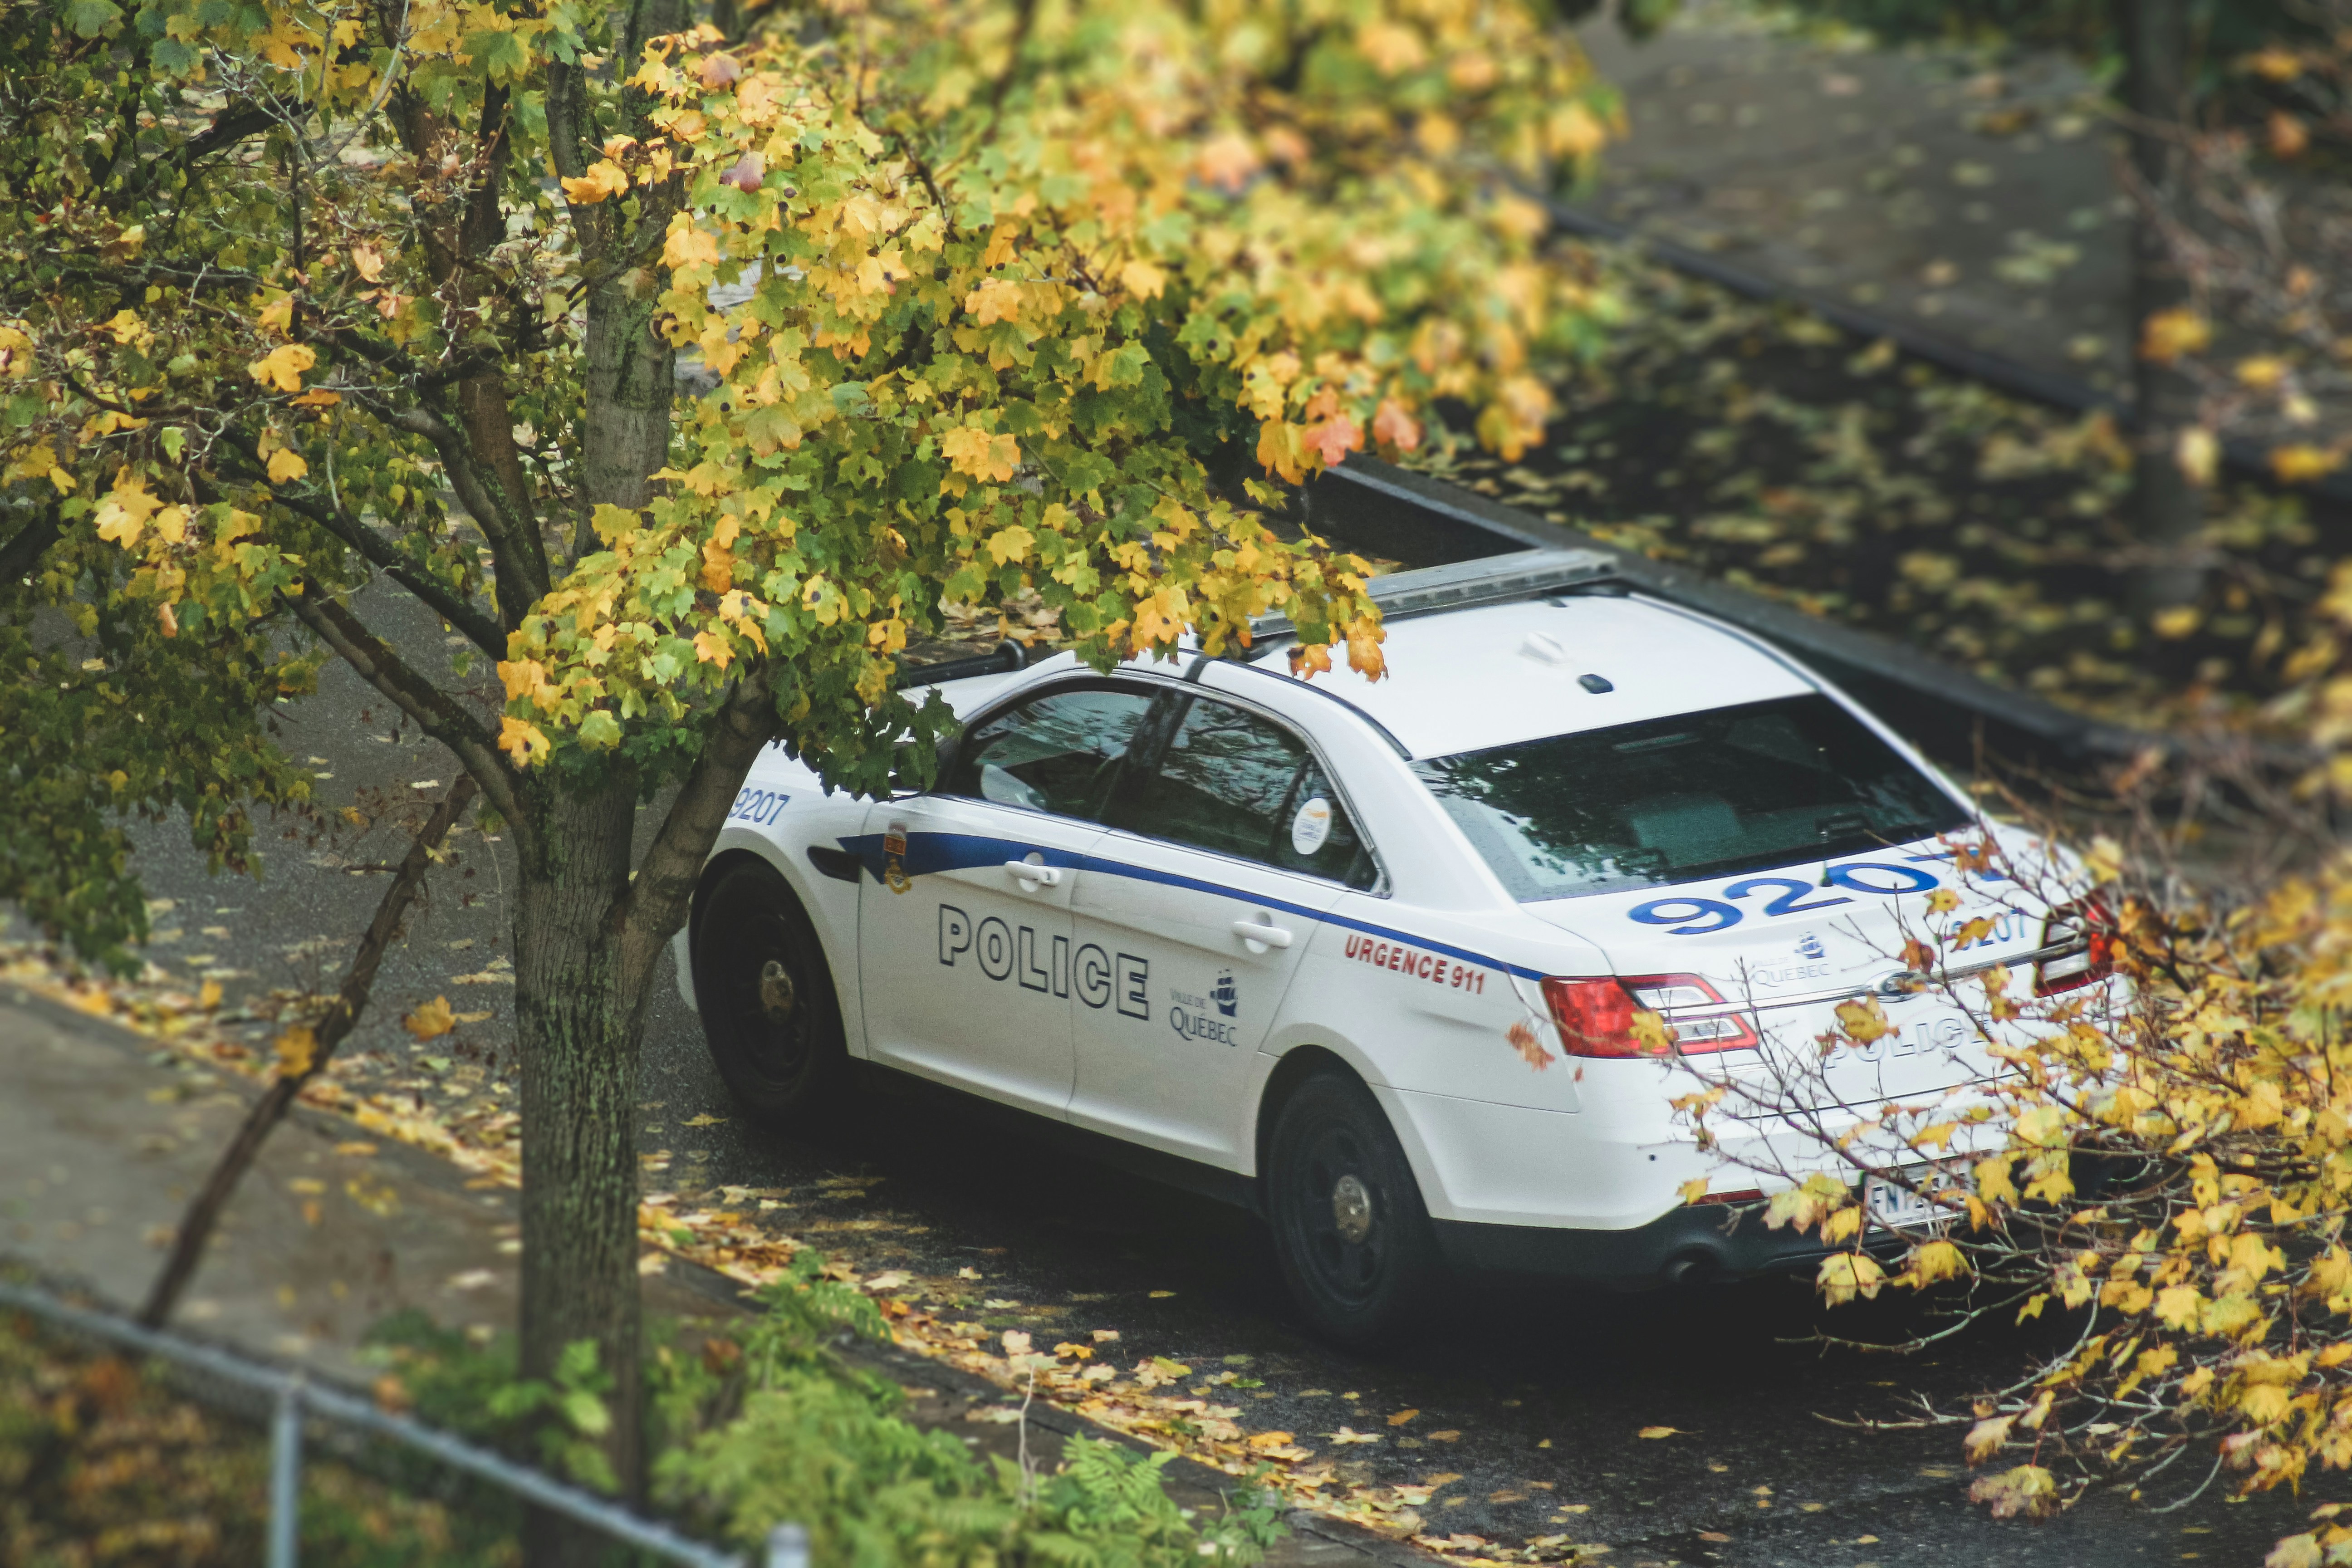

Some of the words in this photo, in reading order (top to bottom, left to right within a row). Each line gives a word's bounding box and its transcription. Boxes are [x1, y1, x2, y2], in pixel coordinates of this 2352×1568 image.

[728, 788, 791, 825] 9207
[939, 903, 1149, 1021] POLICE
[1345, 935, 1447, 983] URGENCE
[1450, 966, 1485, 995] 911
